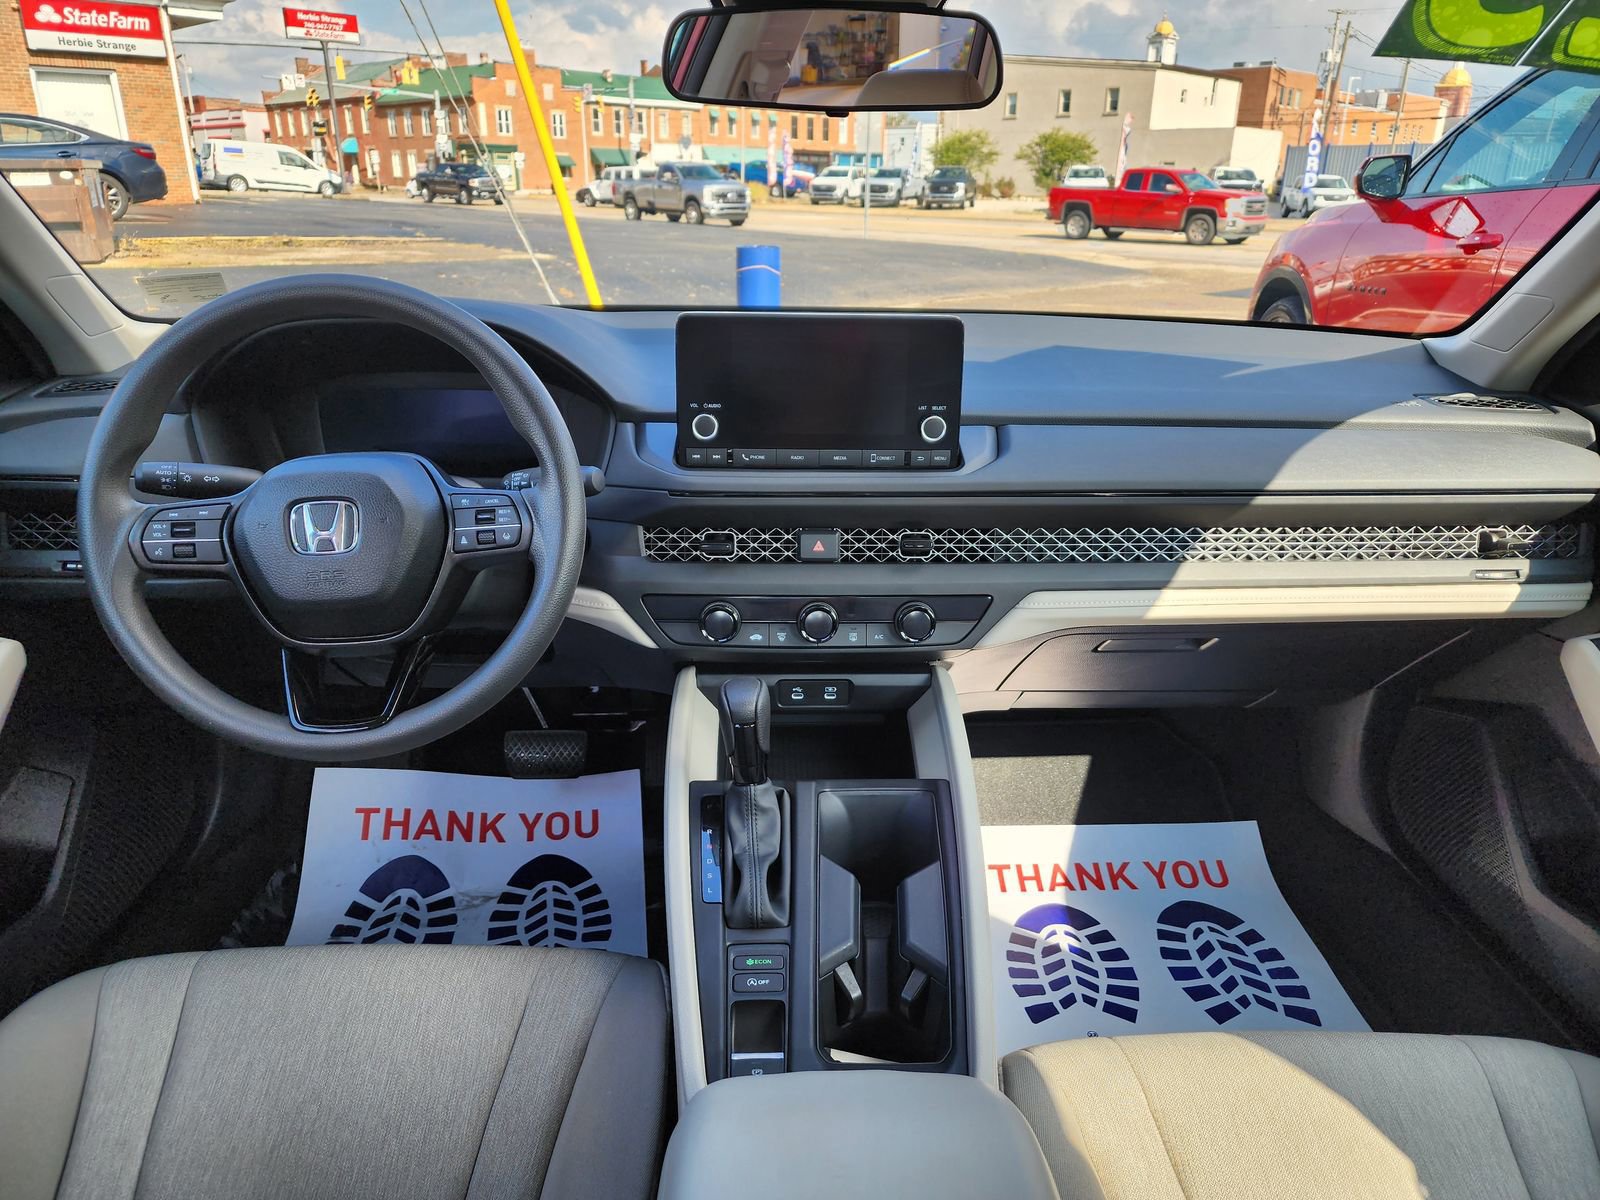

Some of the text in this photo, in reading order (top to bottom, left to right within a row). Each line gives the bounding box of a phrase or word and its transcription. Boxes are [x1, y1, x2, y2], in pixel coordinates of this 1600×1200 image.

[297, 11, 347, 24] Herbie Strange
[57, 36, 137, 52] Herbie Strange
[306, 570, 346, 580] SRS
[354, 807, 600, 843] THANK YOU
[987, 859, 1230, 893] THANK YOU
